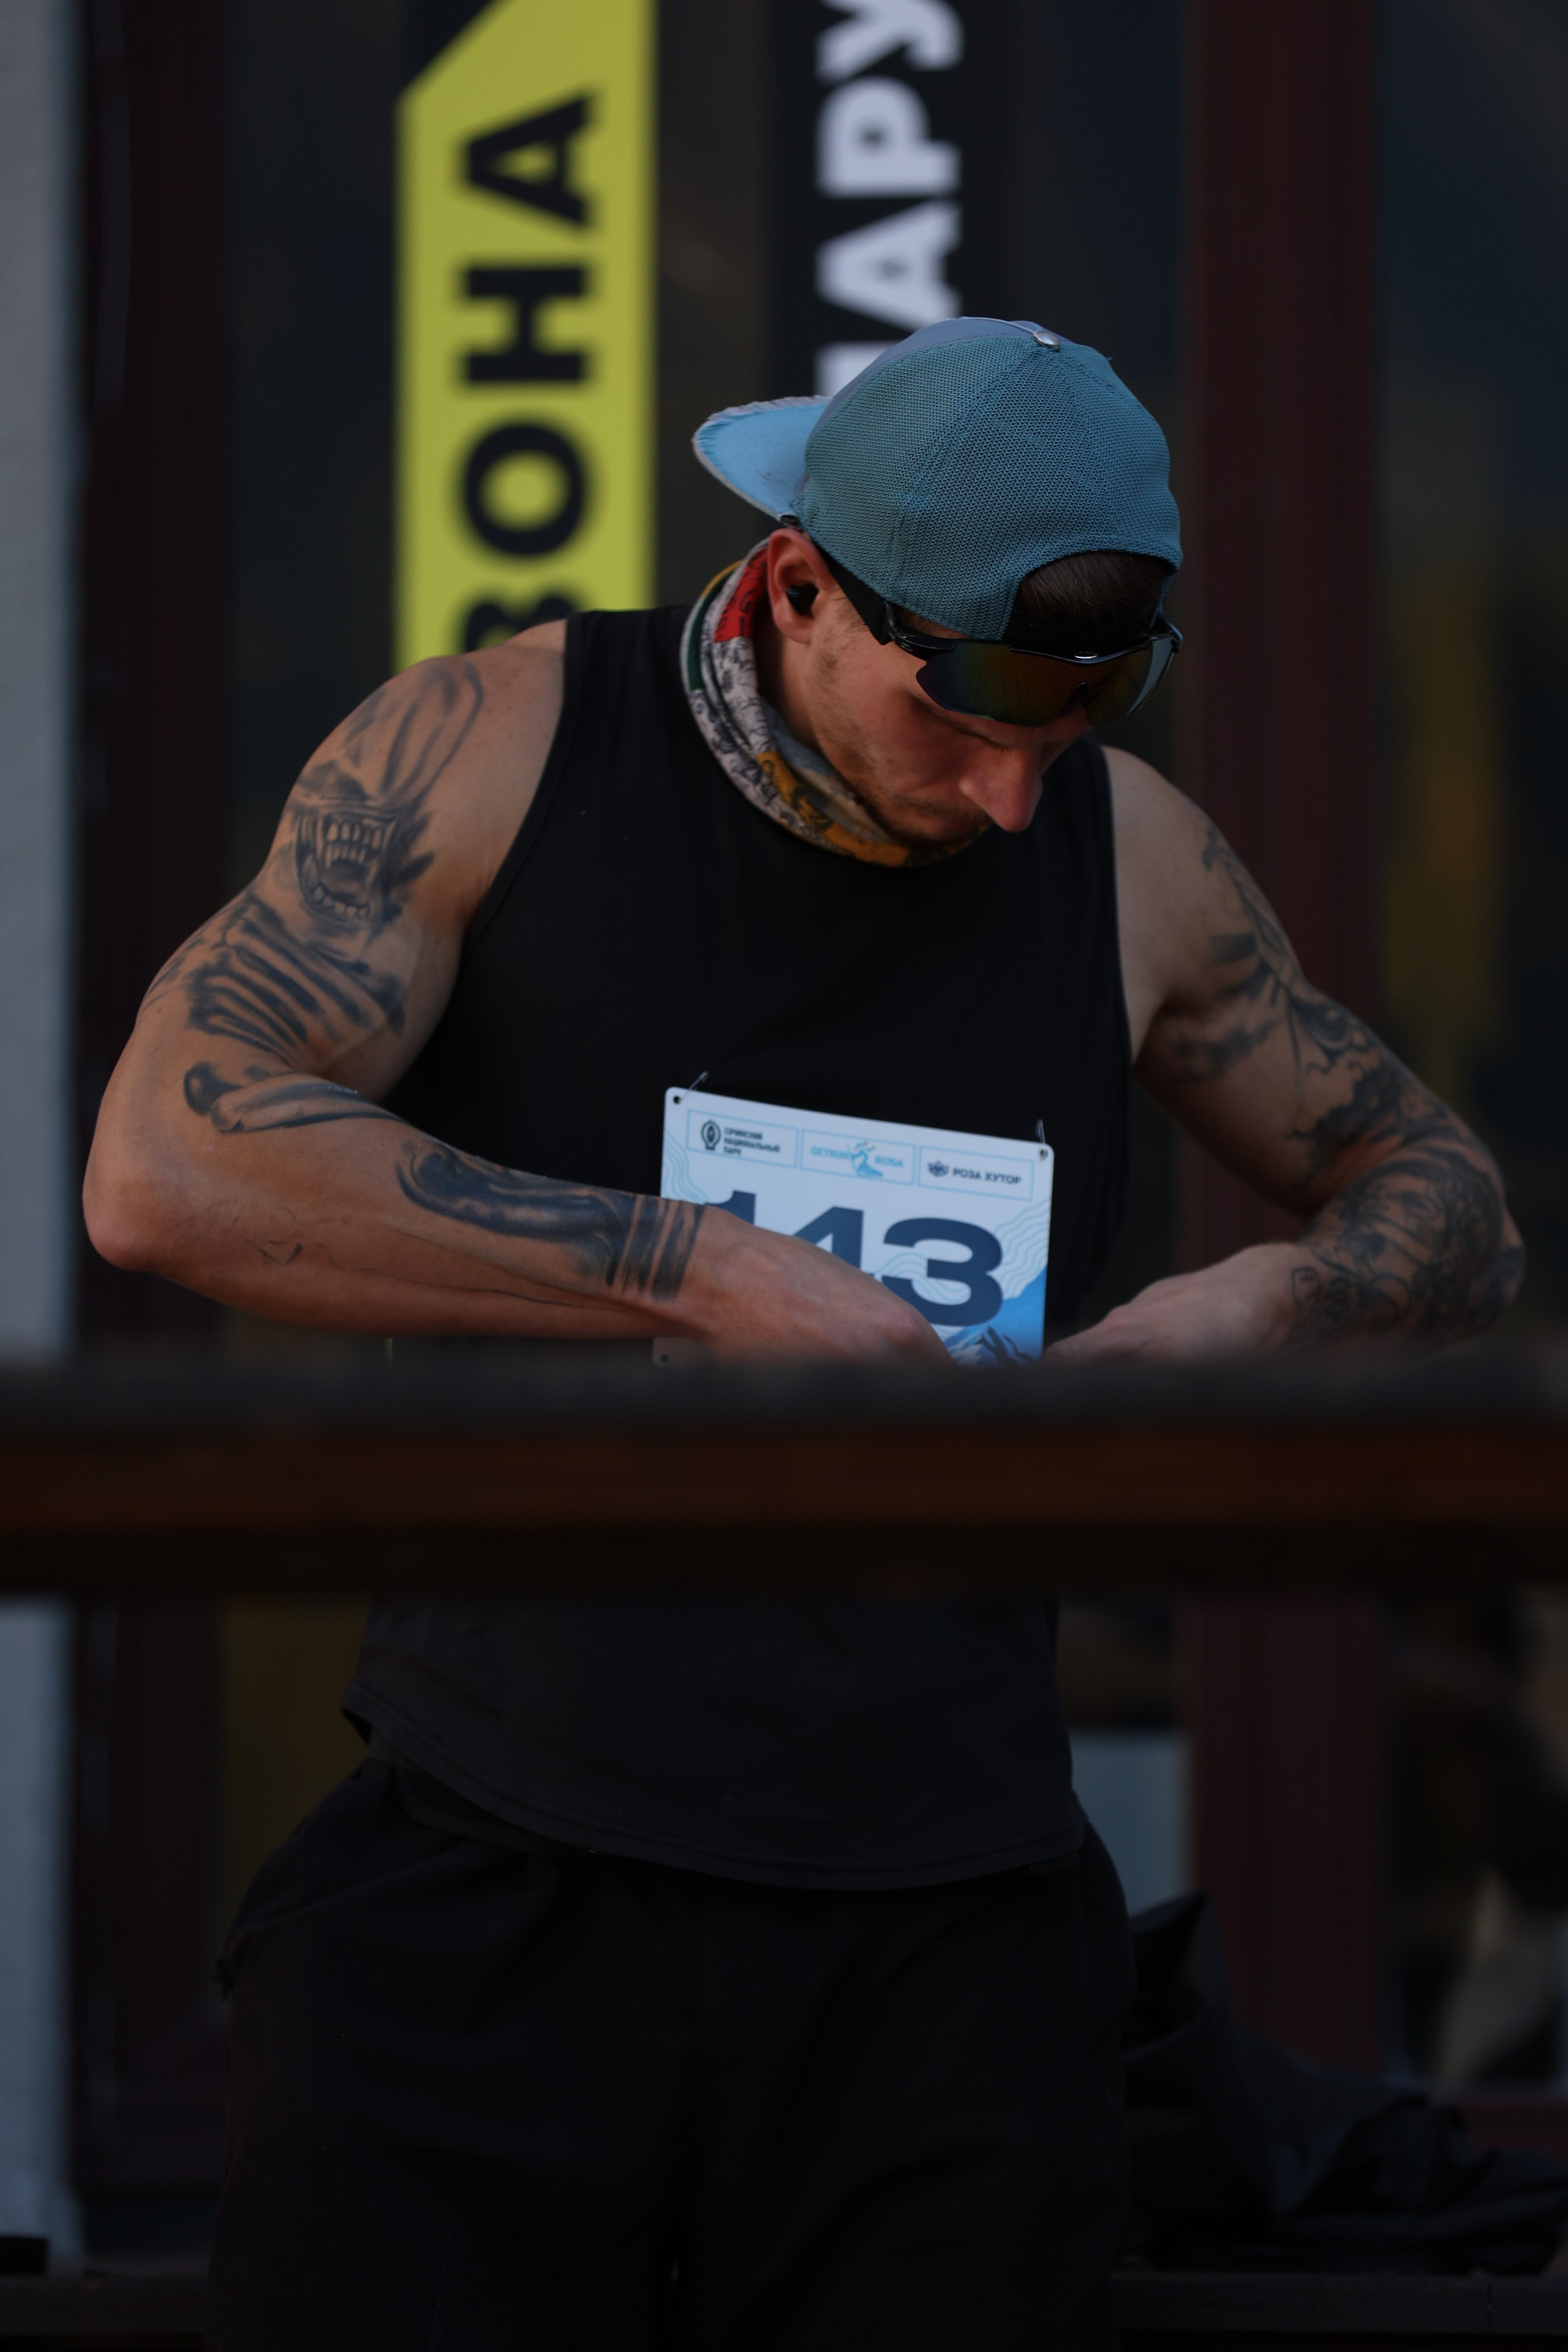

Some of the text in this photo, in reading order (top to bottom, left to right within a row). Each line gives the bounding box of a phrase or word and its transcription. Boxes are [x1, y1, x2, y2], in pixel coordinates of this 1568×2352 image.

[815, 0, 963, 397] АРУ
[954, 1167, 1022, 1185] РОЗА ХУТОР
